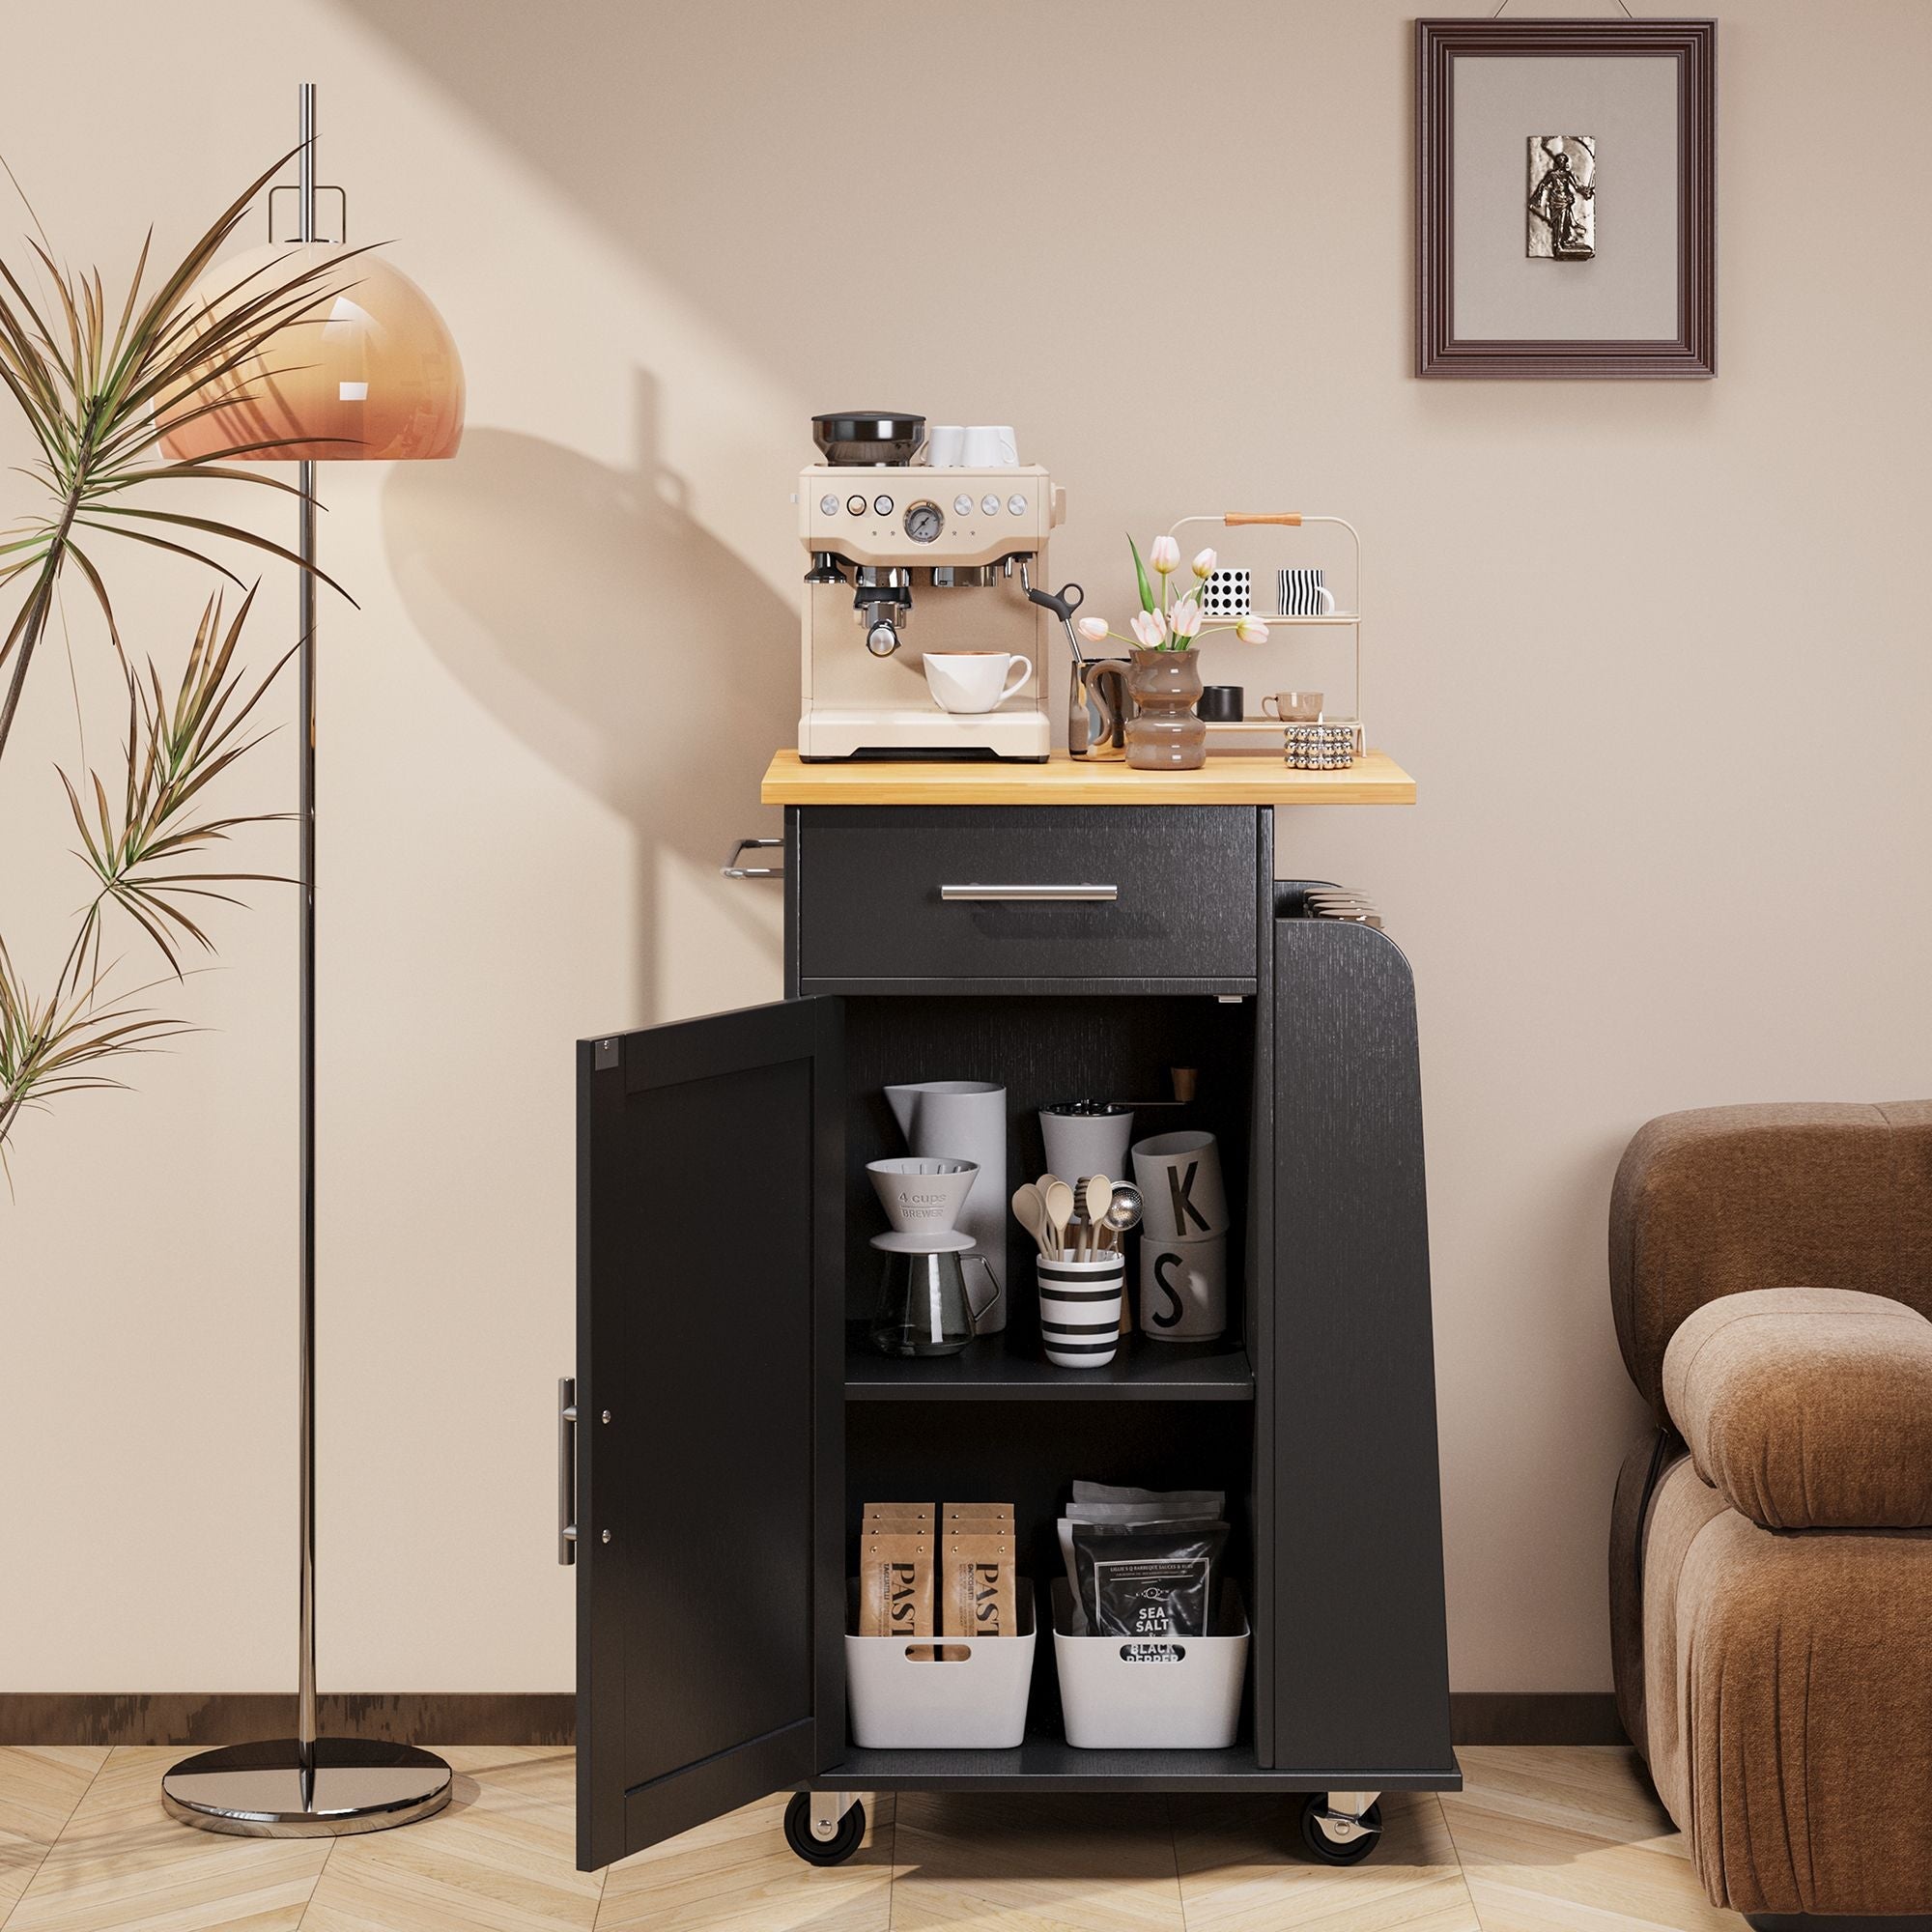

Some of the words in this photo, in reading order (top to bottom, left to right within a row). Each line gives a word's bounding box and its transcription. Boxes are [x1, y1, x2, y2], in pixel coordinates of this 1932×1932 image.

[898, 1192, 908, 1203] 4
[1167, 1161, 1211, 1236] K
[901, 1208, 943, 1218] BREWER
[1151, 1253, 1183, 1328] S
[892, 1562, 915, 1635] PAST
[976, 1562, 999, 1636] PAST
[1139, 1606, 1165, 1620] SEA
[1136, 1619, 1169, 1633] SALT
[1130, 1644, 1175, 1655] BLACK
